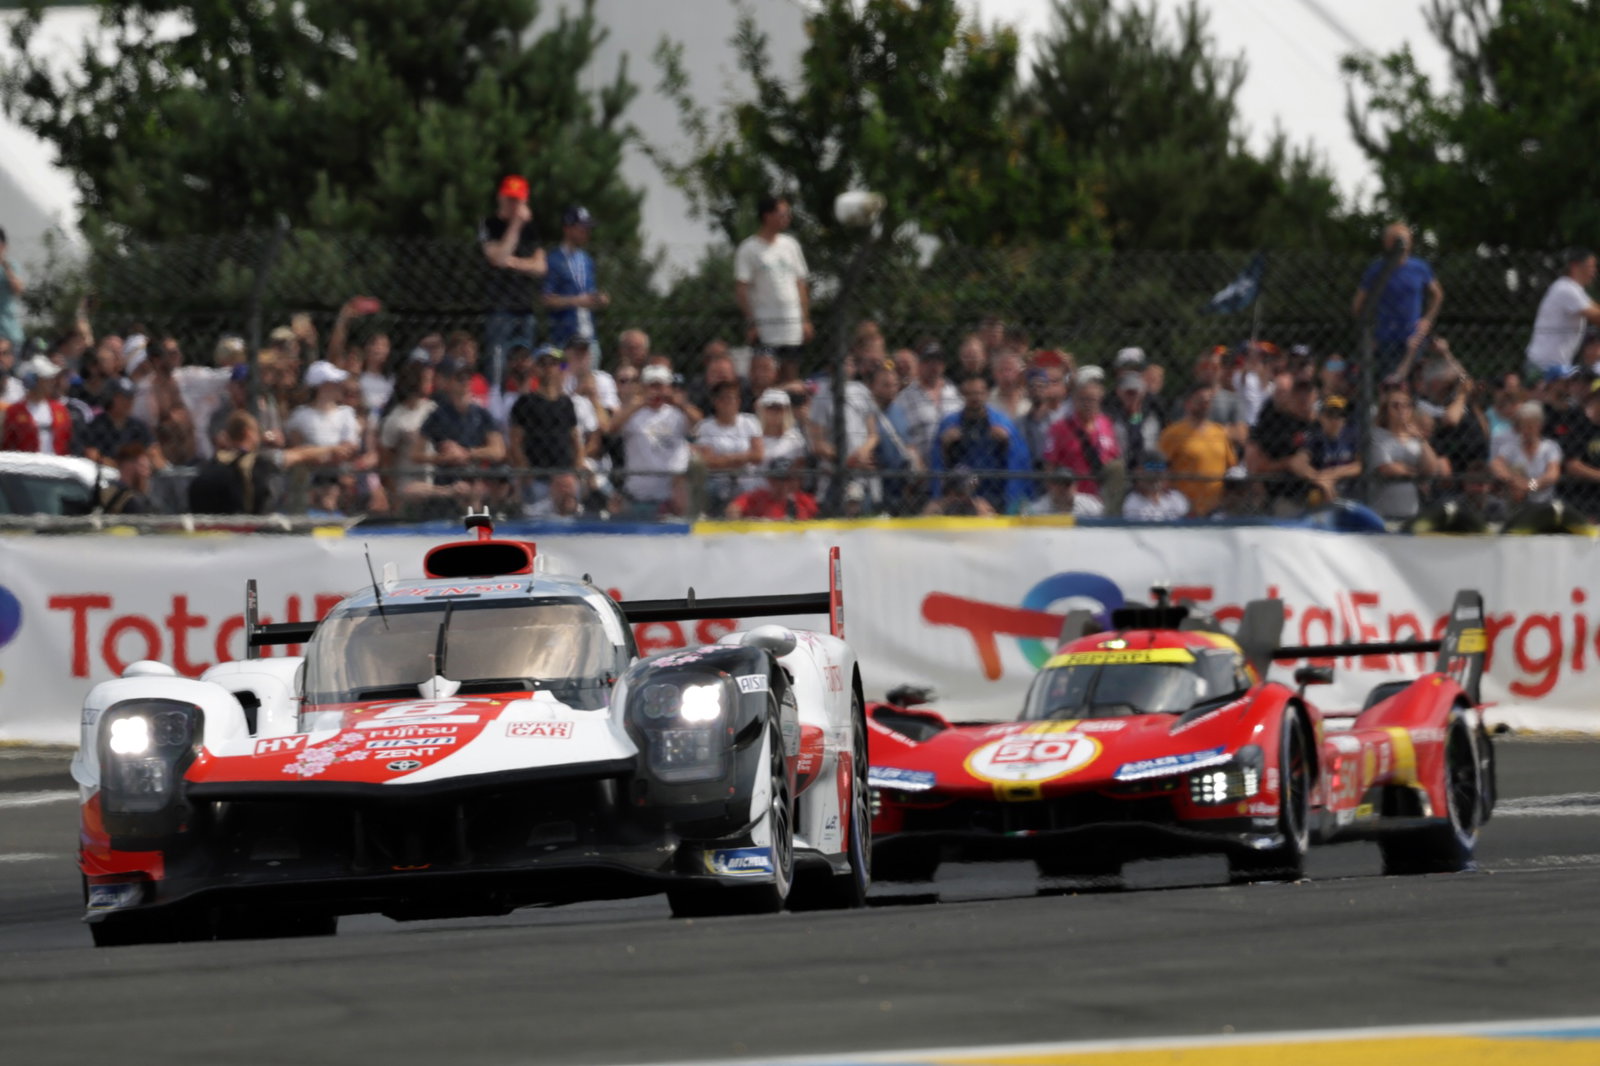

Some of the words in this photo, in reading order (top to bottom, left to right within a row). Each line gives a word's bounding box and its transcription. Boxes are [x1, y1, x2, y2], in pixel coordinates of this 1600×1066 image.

[369, 725, 459, 739] FUJITSU
[511, 727, 567, 736] CAR
[256, 737, 305, 754] HY
[369, 736, 454, 749] AISIN
[374, 746, 440, 759] ZENT
[996, 741, 1071, 761] 50
